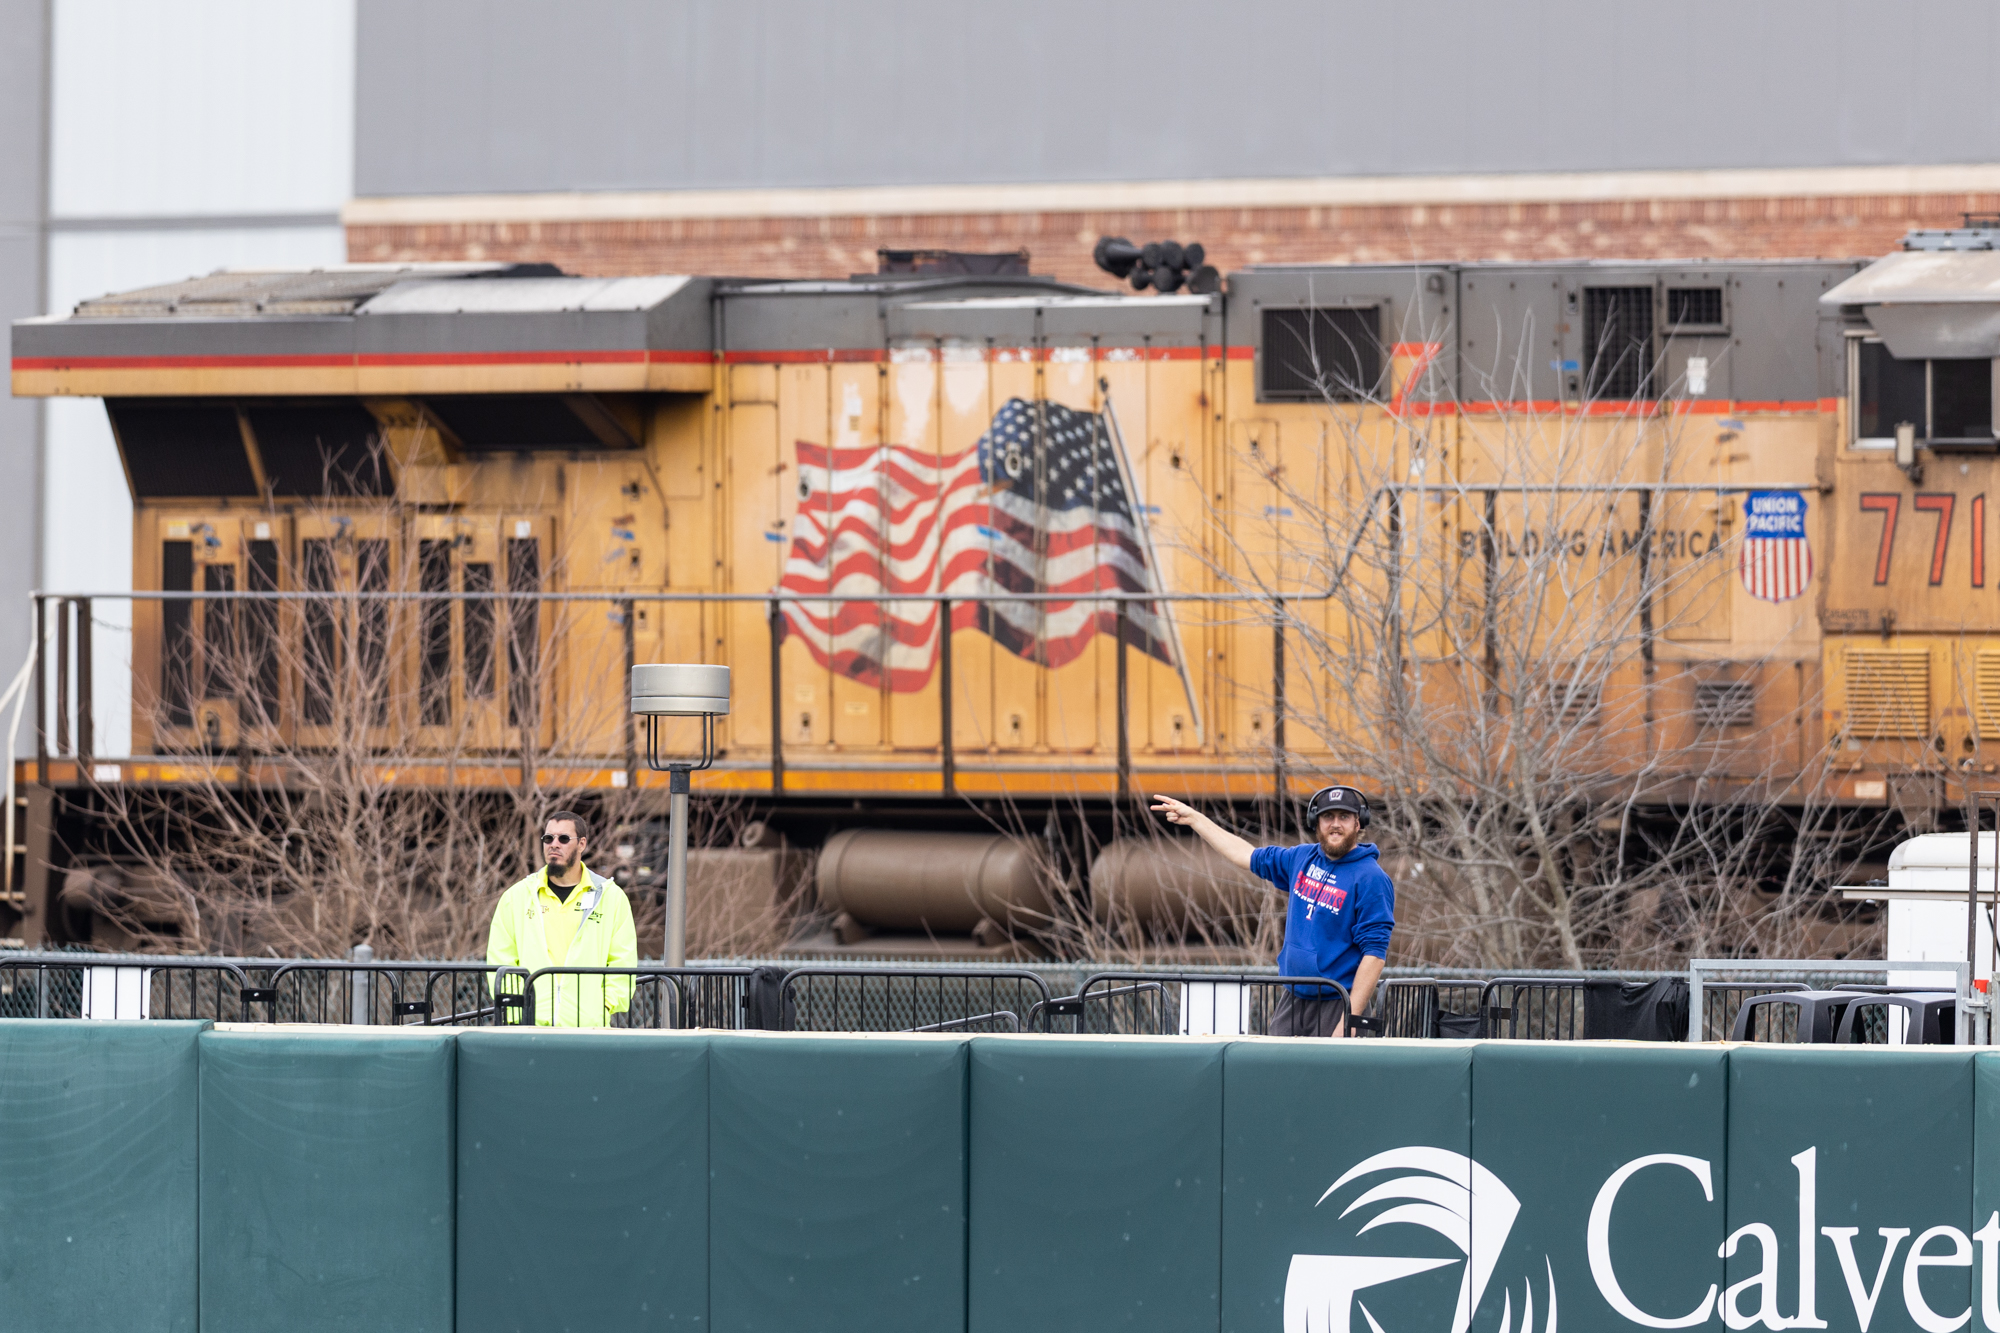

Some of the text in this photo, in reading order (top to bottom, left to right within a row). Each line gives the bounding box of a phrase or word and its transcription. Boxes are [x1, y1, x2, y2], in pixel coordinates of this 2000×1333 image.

[1750, 514, 1801, 532] PACIFIC
[1752, 496, 1798, 513] UNION
[1860, 492, 2000, 589] 771
[1293, 872, 1342, 912] CHAMIONS
[1587, 1145, 2000, 1333] Calvet
